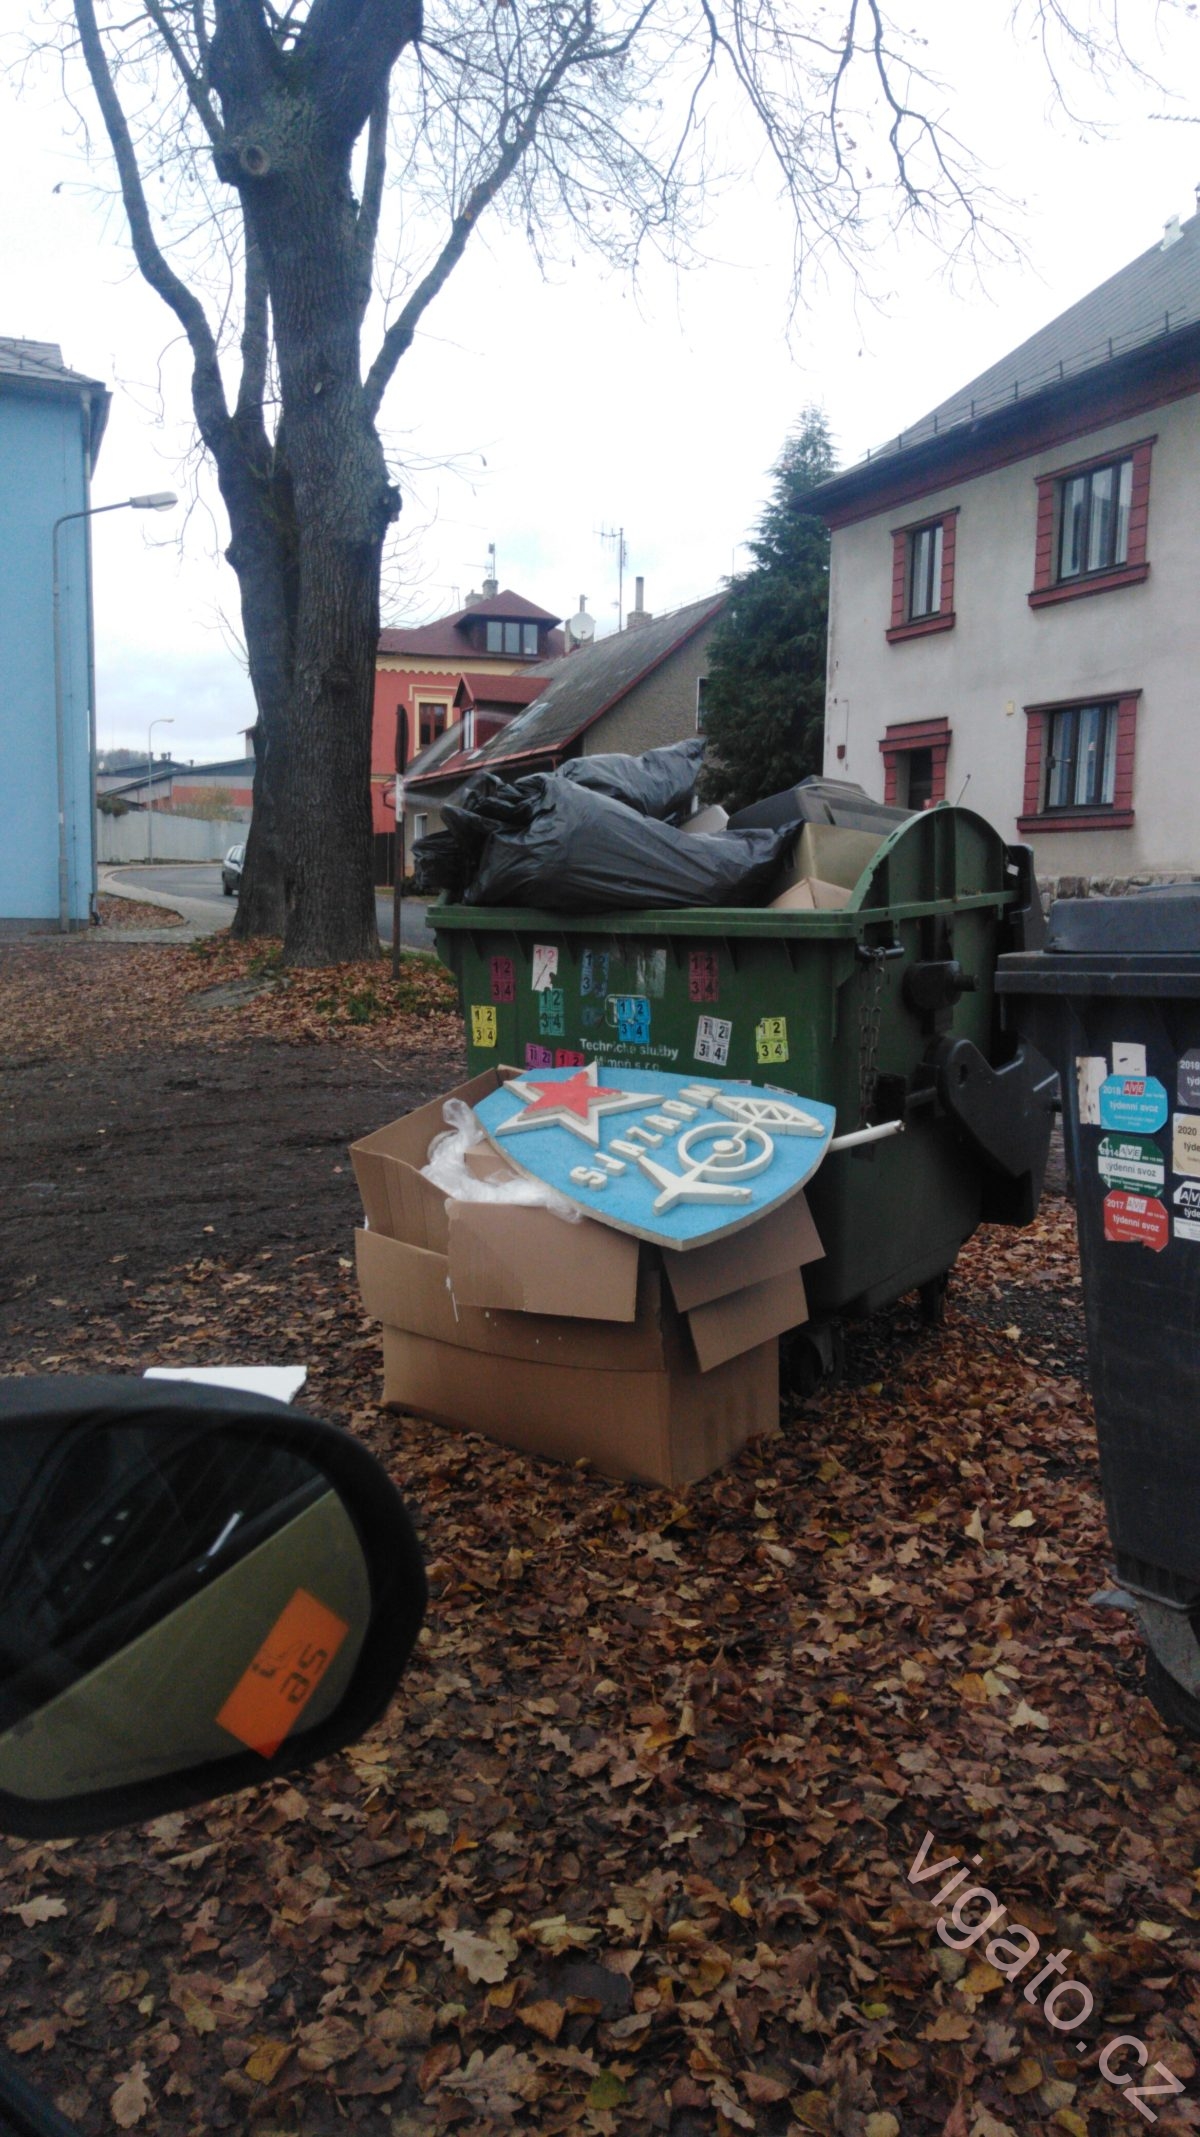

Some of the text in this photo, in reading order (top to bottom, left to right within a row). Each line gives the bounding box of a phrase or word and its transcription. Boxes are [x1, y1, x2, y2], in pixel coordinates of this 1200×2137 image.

[1123, 1081, 1146, 1095] AVE
[1109, 1101, 1159, 1113] týdenní svoz
[1177, 1126, 1198, 1136] 2020
[1137, 1167, 1157, 1178] svoz
[1106, 1200, 1124, 1209] 2017
[1112, 1214, 1140, 1228] týdenní
[1141, 1221, 1160, 1233] svoz
